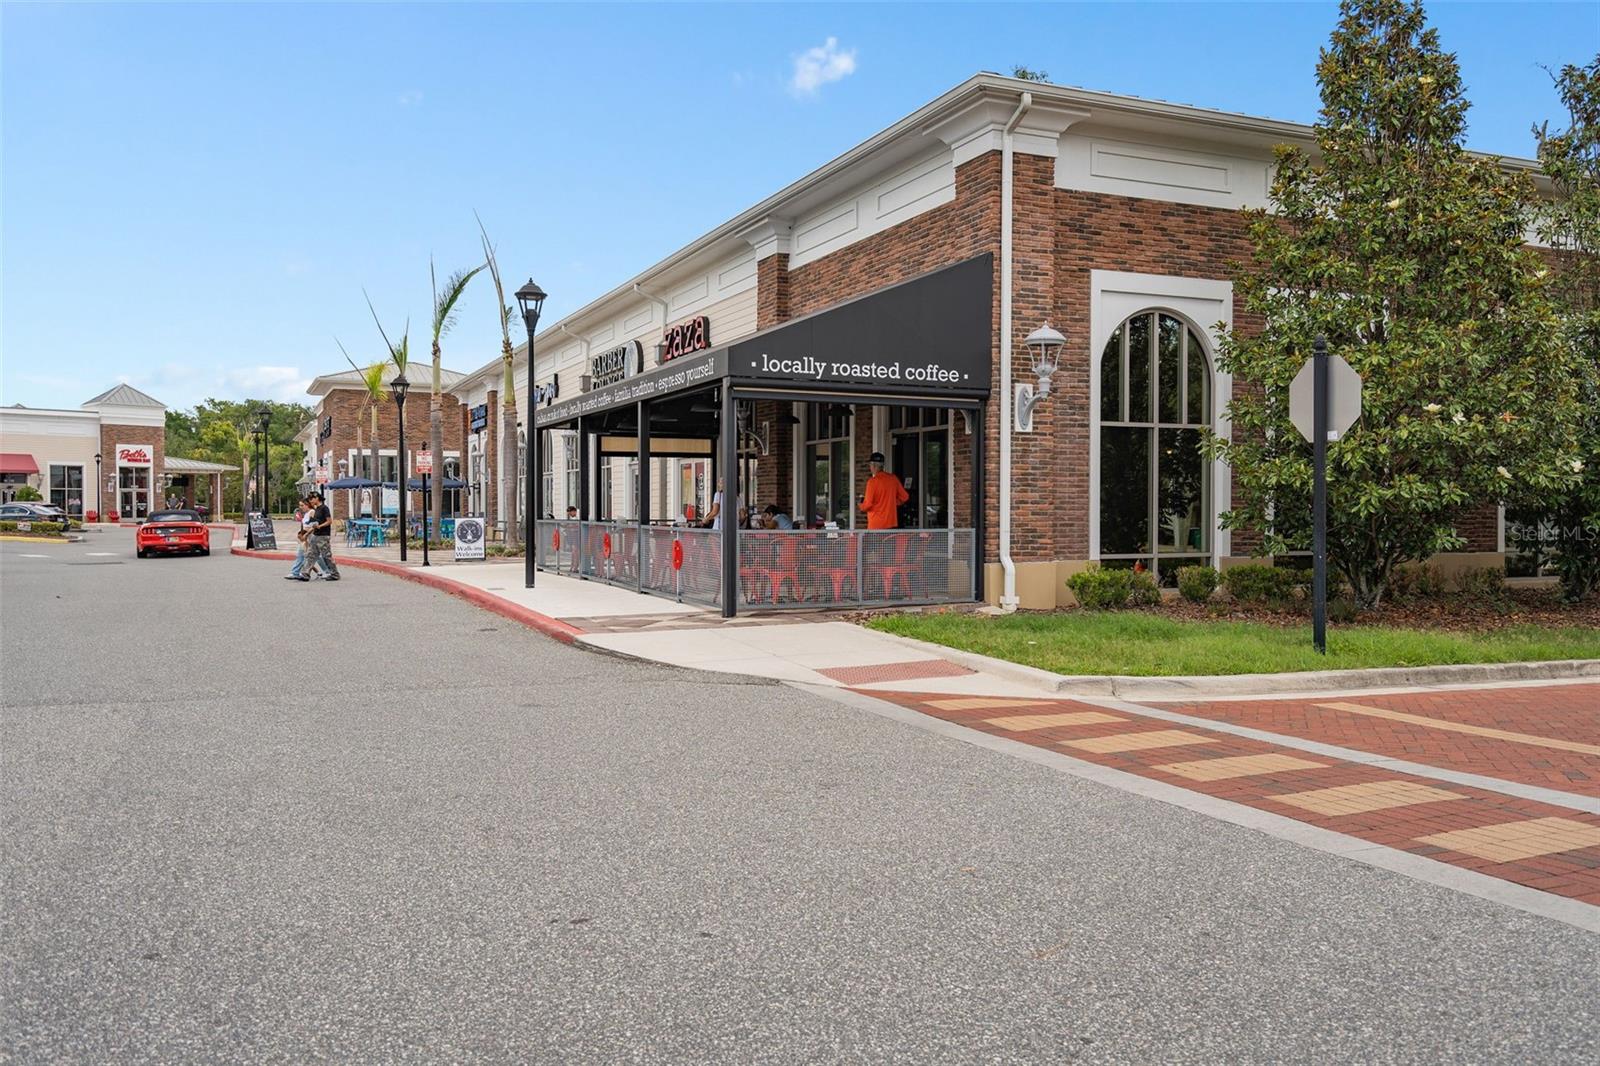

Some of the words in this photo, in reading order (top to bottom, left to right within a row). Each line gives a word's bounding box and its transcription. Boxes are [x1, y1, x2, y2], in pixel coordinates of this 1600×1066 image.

[664, 316, 707, 361] zaza
[592, 347, 625, 377] BARBER
[659, 370, 686, 393] espresso
[686, 357, 714, 386] yourself
[762, 354, 827, 379] locally
[831, 362, 900, 380] roasted
[905, 365, 960, 382] coffee
